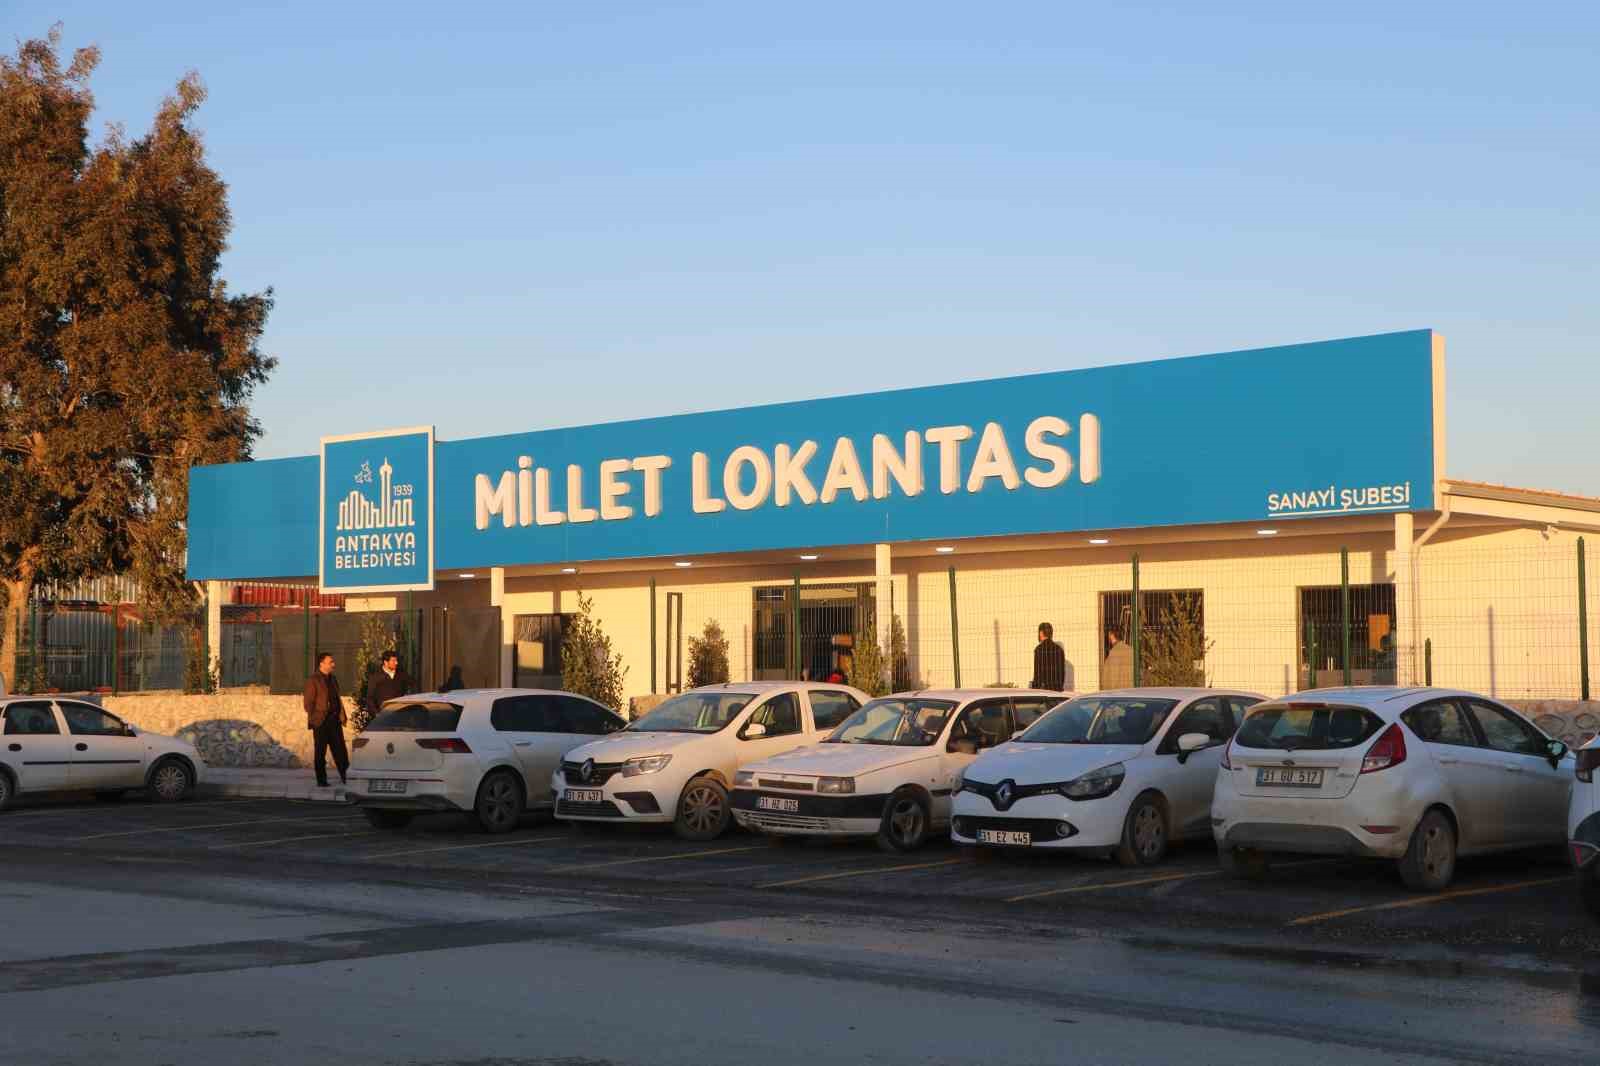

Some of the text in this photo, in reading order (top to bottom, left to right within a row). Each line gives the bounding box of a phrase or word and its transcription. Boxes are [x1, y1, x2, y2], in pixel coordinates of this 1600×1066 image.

[474, 412, 1102, 529] MİLLET LOKANTASI
[393, 484, 413, 497] 1939
[1268, 481, 1411, 510] SANAYİ ŞUBESİ
[335, 532, 416, 552] ANTAKYA
